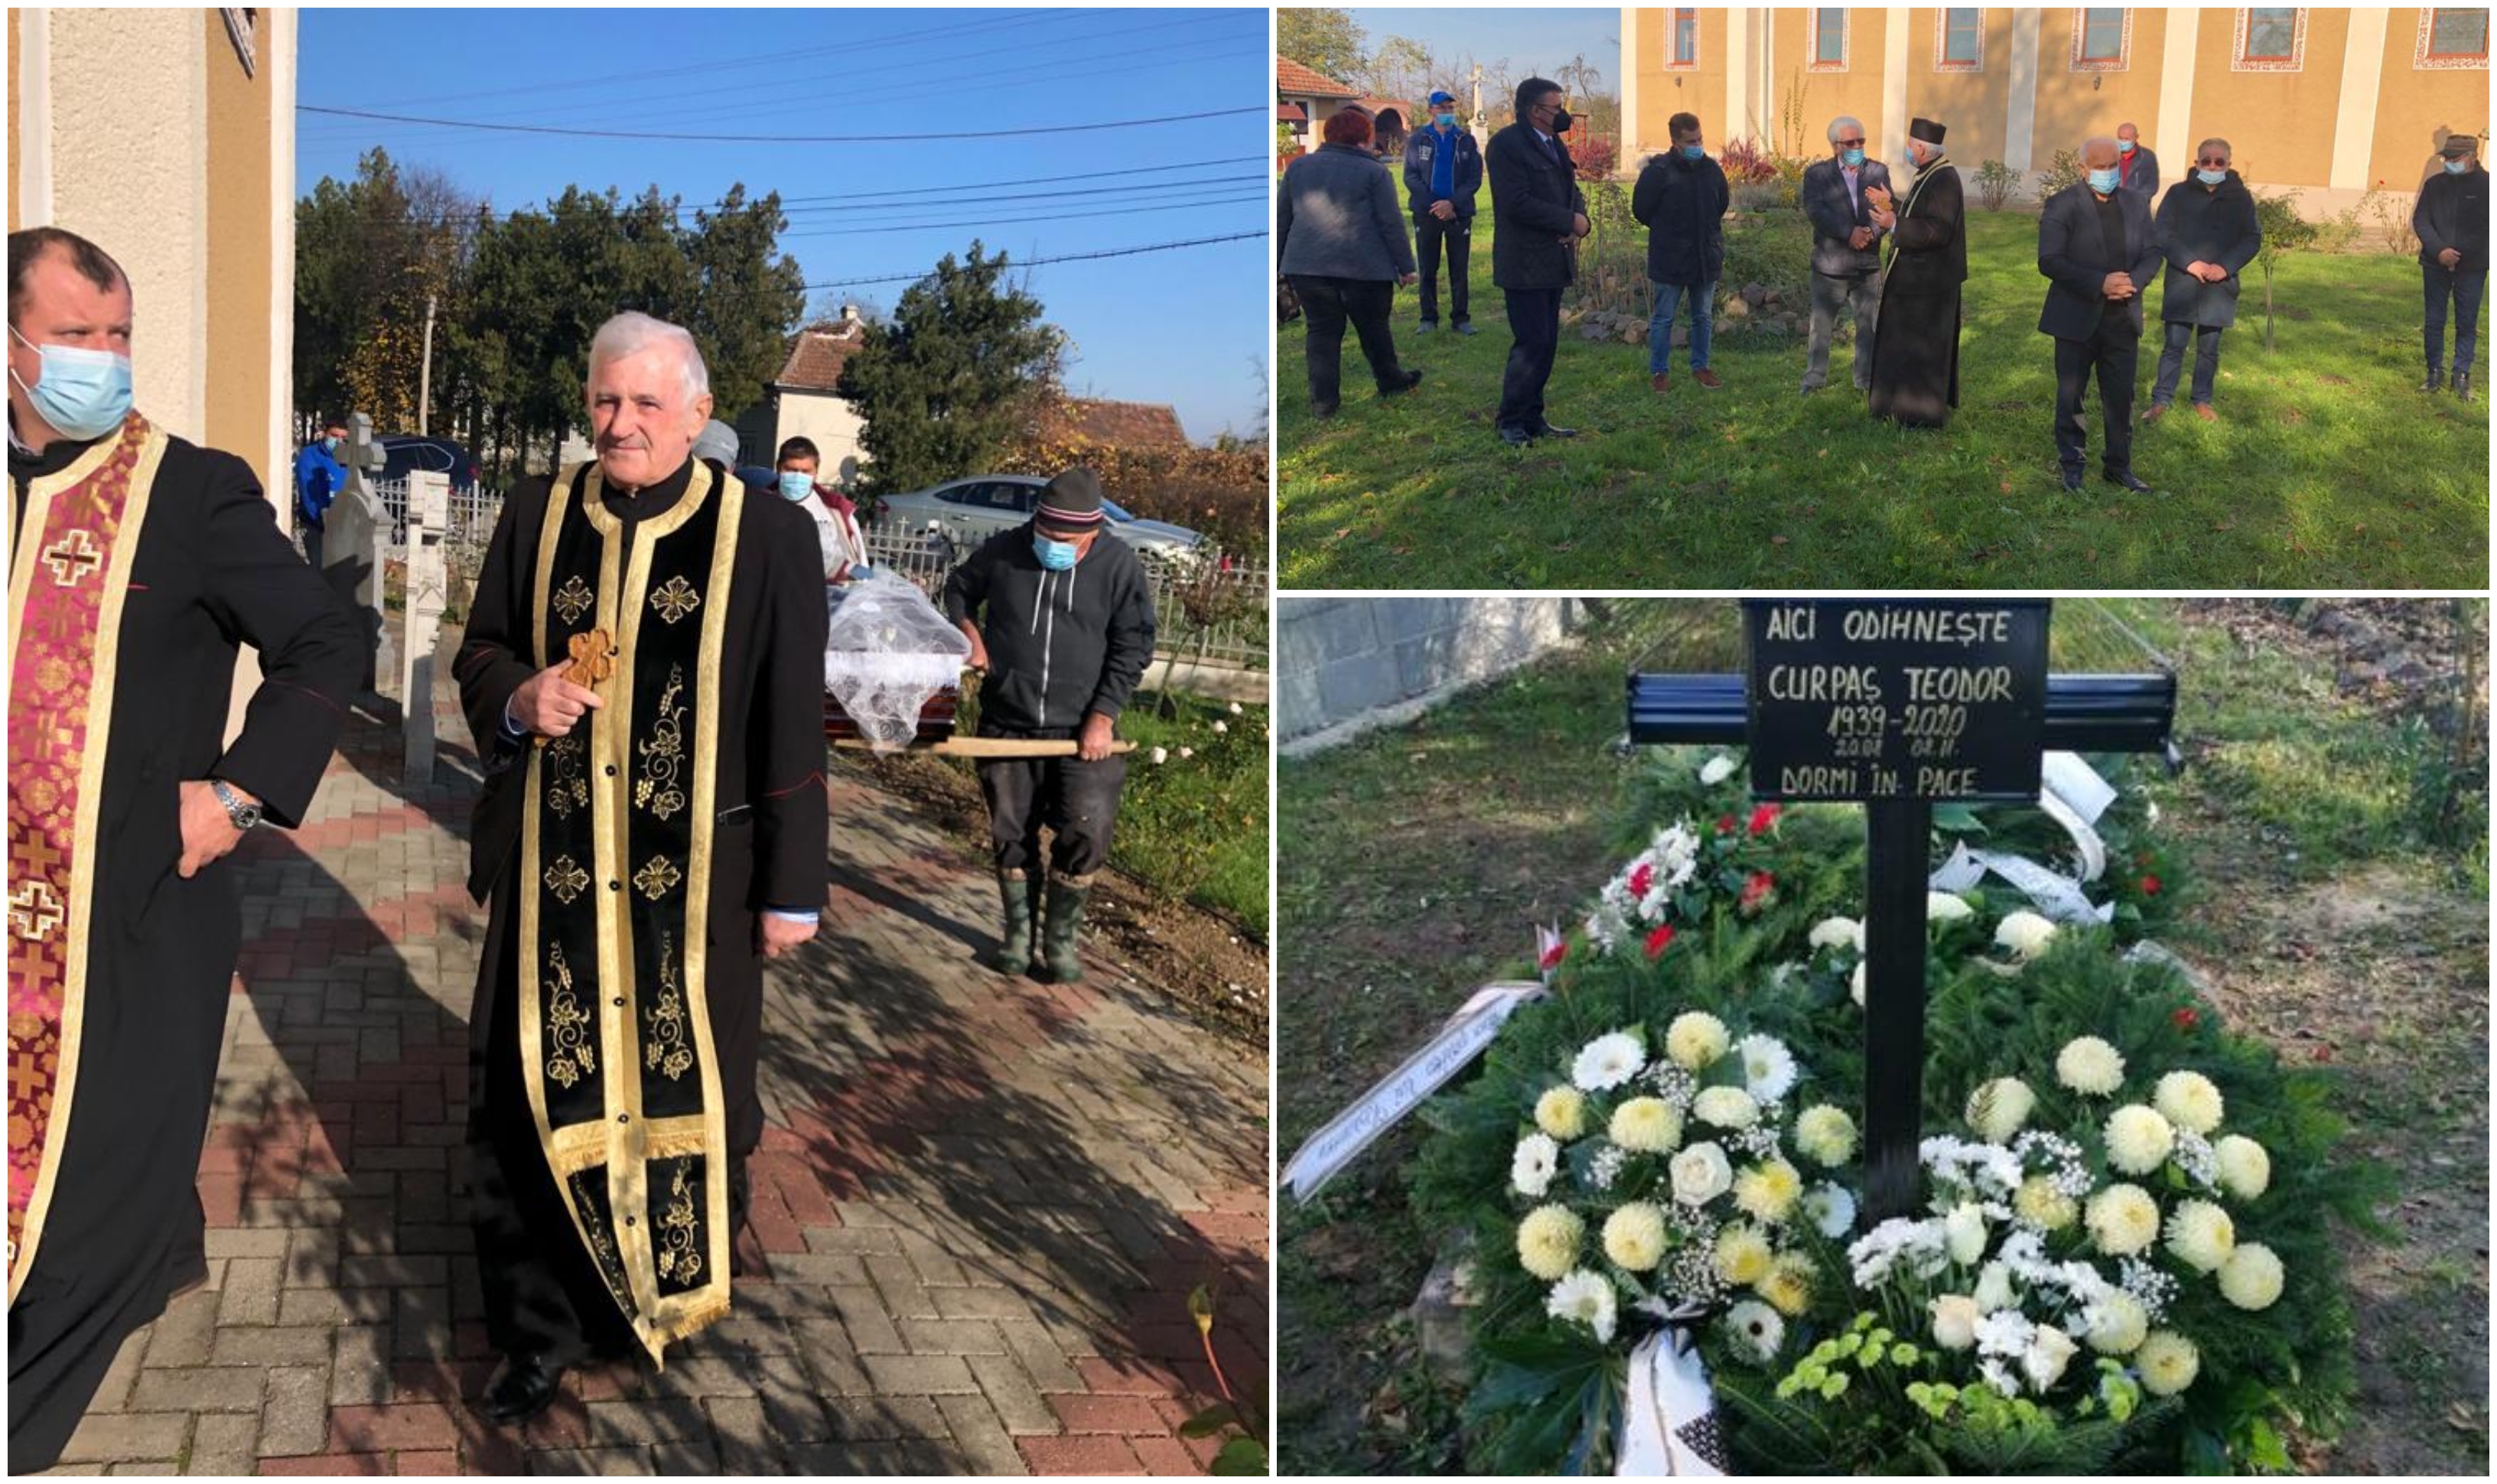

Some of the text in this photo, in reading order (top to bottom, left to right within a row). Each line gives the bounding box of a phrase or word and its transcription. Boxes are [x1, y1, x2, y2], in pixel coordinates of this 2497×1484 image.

[1766, 608, 1815, 641] AICI
[1903, 666, 2014, 701] TEODOR
[1827, 705, 1967, 738] 1939-2020
[1782, 762, 1857, 795] DORMI
[1917, 766, 1978, 796] PACE
